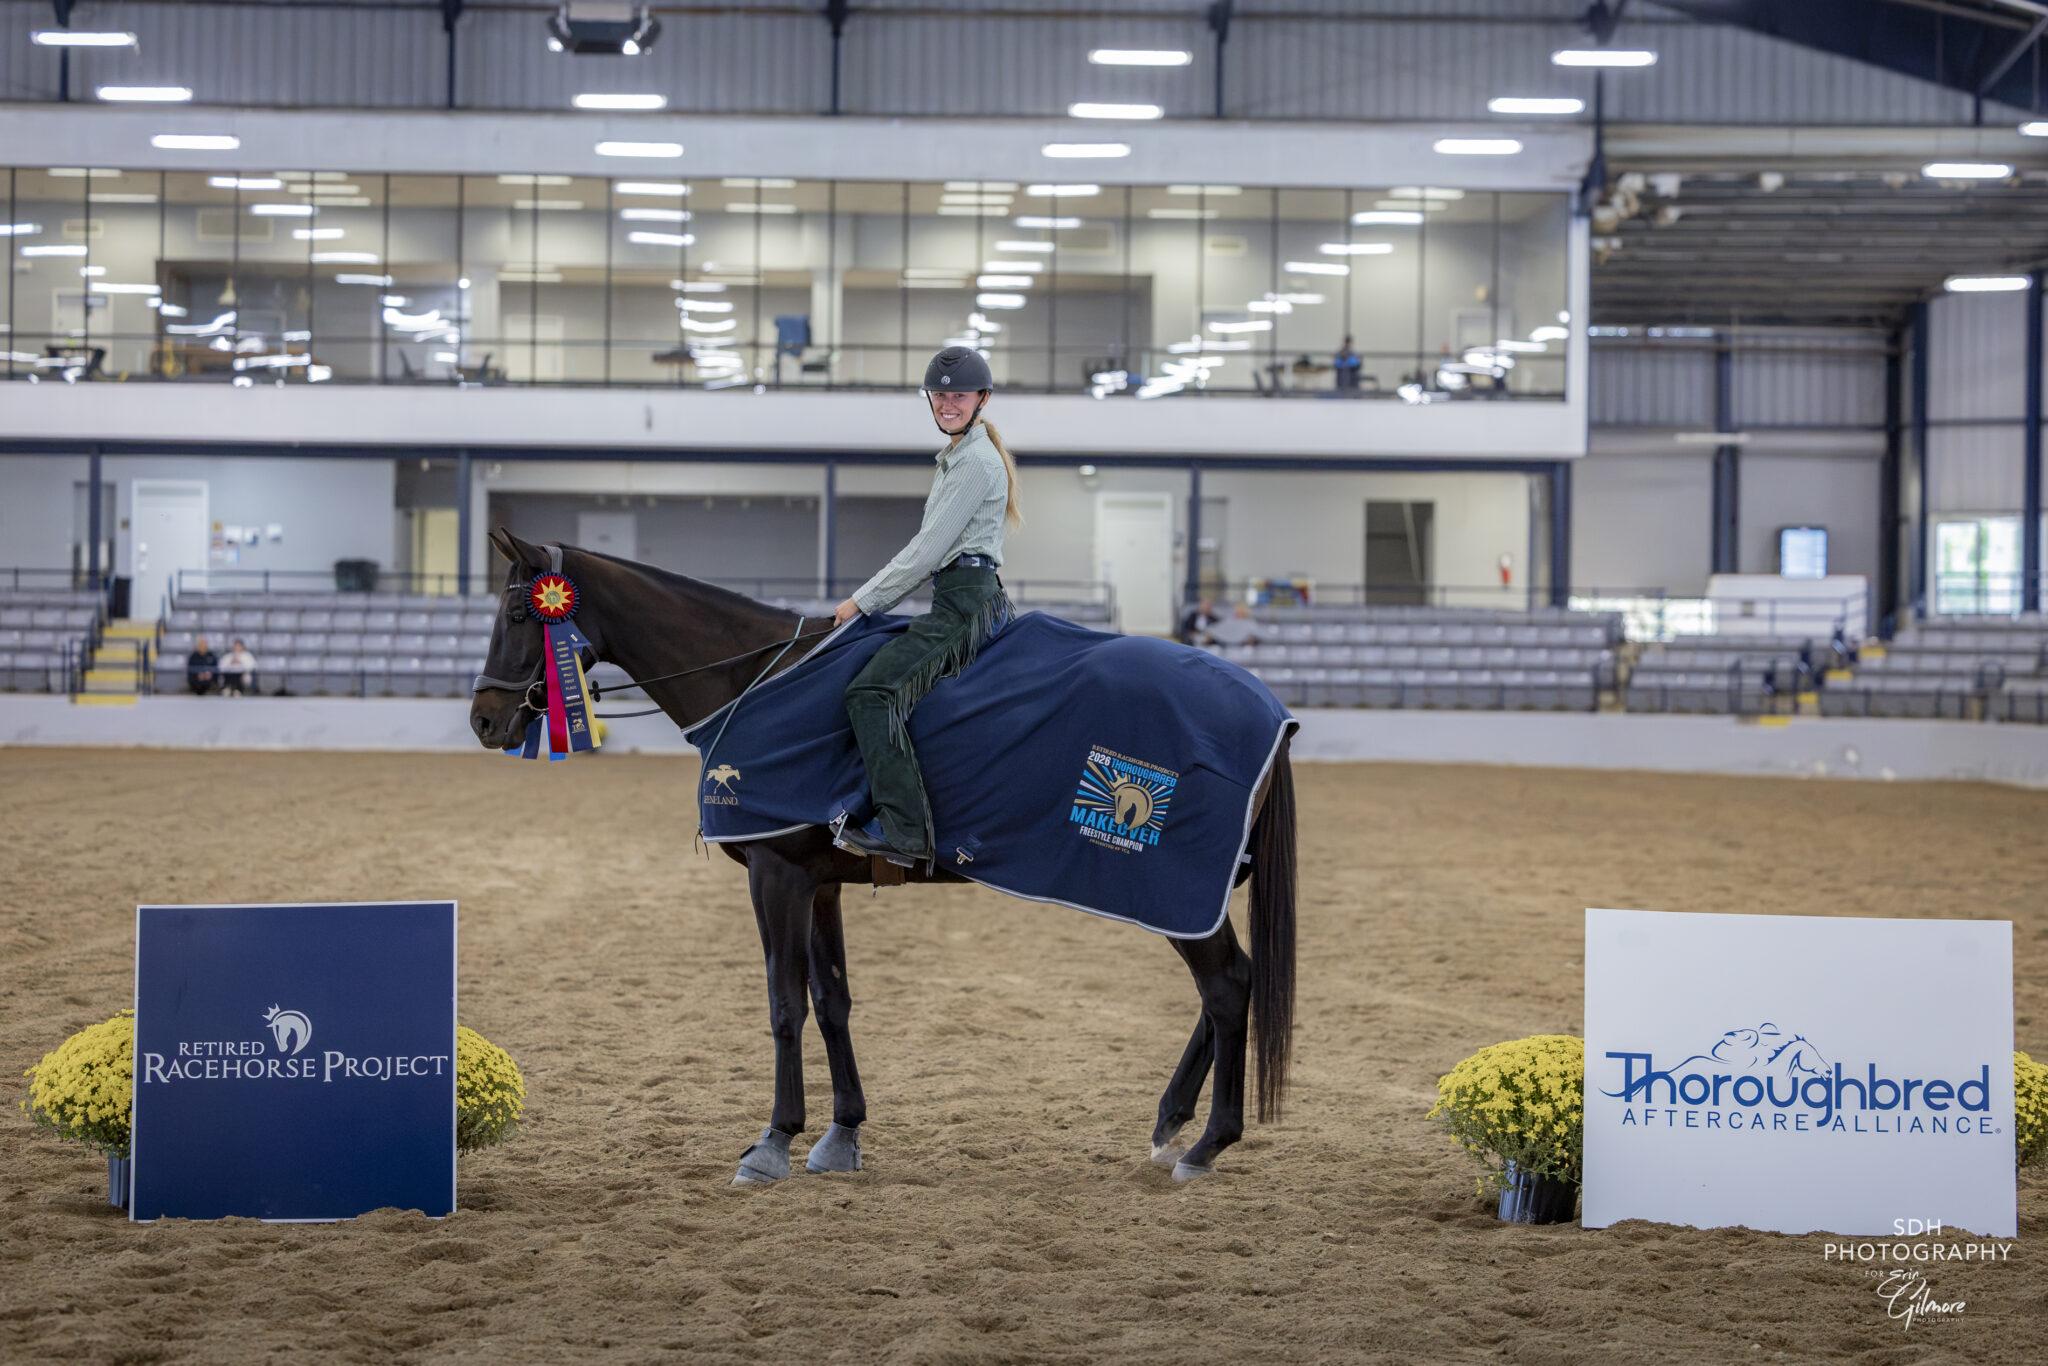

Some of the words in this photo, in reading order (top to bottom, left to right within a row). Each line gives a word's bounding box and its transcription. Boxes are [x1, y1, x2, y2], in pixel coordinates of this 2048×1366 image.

[1087, 751, 1111, 766] 2026
[1111, 757, 1177, 787] THOROUGHBRED
[1069, 805, 1161, 847] MAKEOVER
[1079, 825, 1111, 843] FREESTYLE
[1111, 836, 1144, 852] CHAMPION
[179, 1041, 265, 1056] RETIRED
[143, 1052, 316, 1084] RACEHORSE
[323, 1051, 448, 1082] PROJECT
[1602, 1052, 1990, 1127] Thoroughbred
[1622, 1108, 1809, 1131] AFTERCARE
